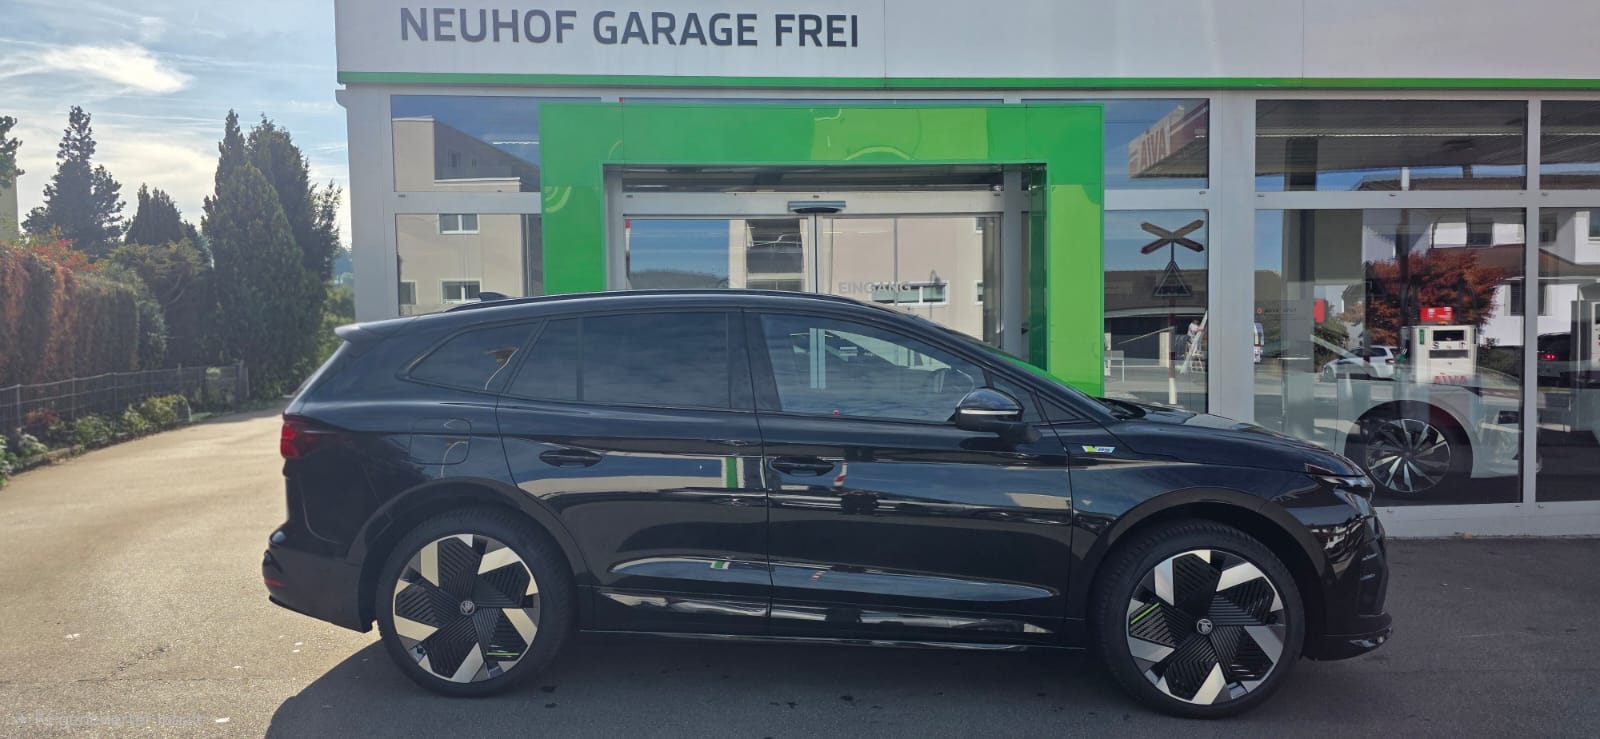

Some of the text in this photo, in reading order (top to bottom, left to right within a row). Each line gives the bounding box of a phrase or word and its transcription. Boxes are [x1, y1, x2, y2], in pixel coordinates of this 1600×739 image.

[400, 7, 859, 48] NEUHOF GARAGE FREI
[838, 281, 911, 294] EINGANG
